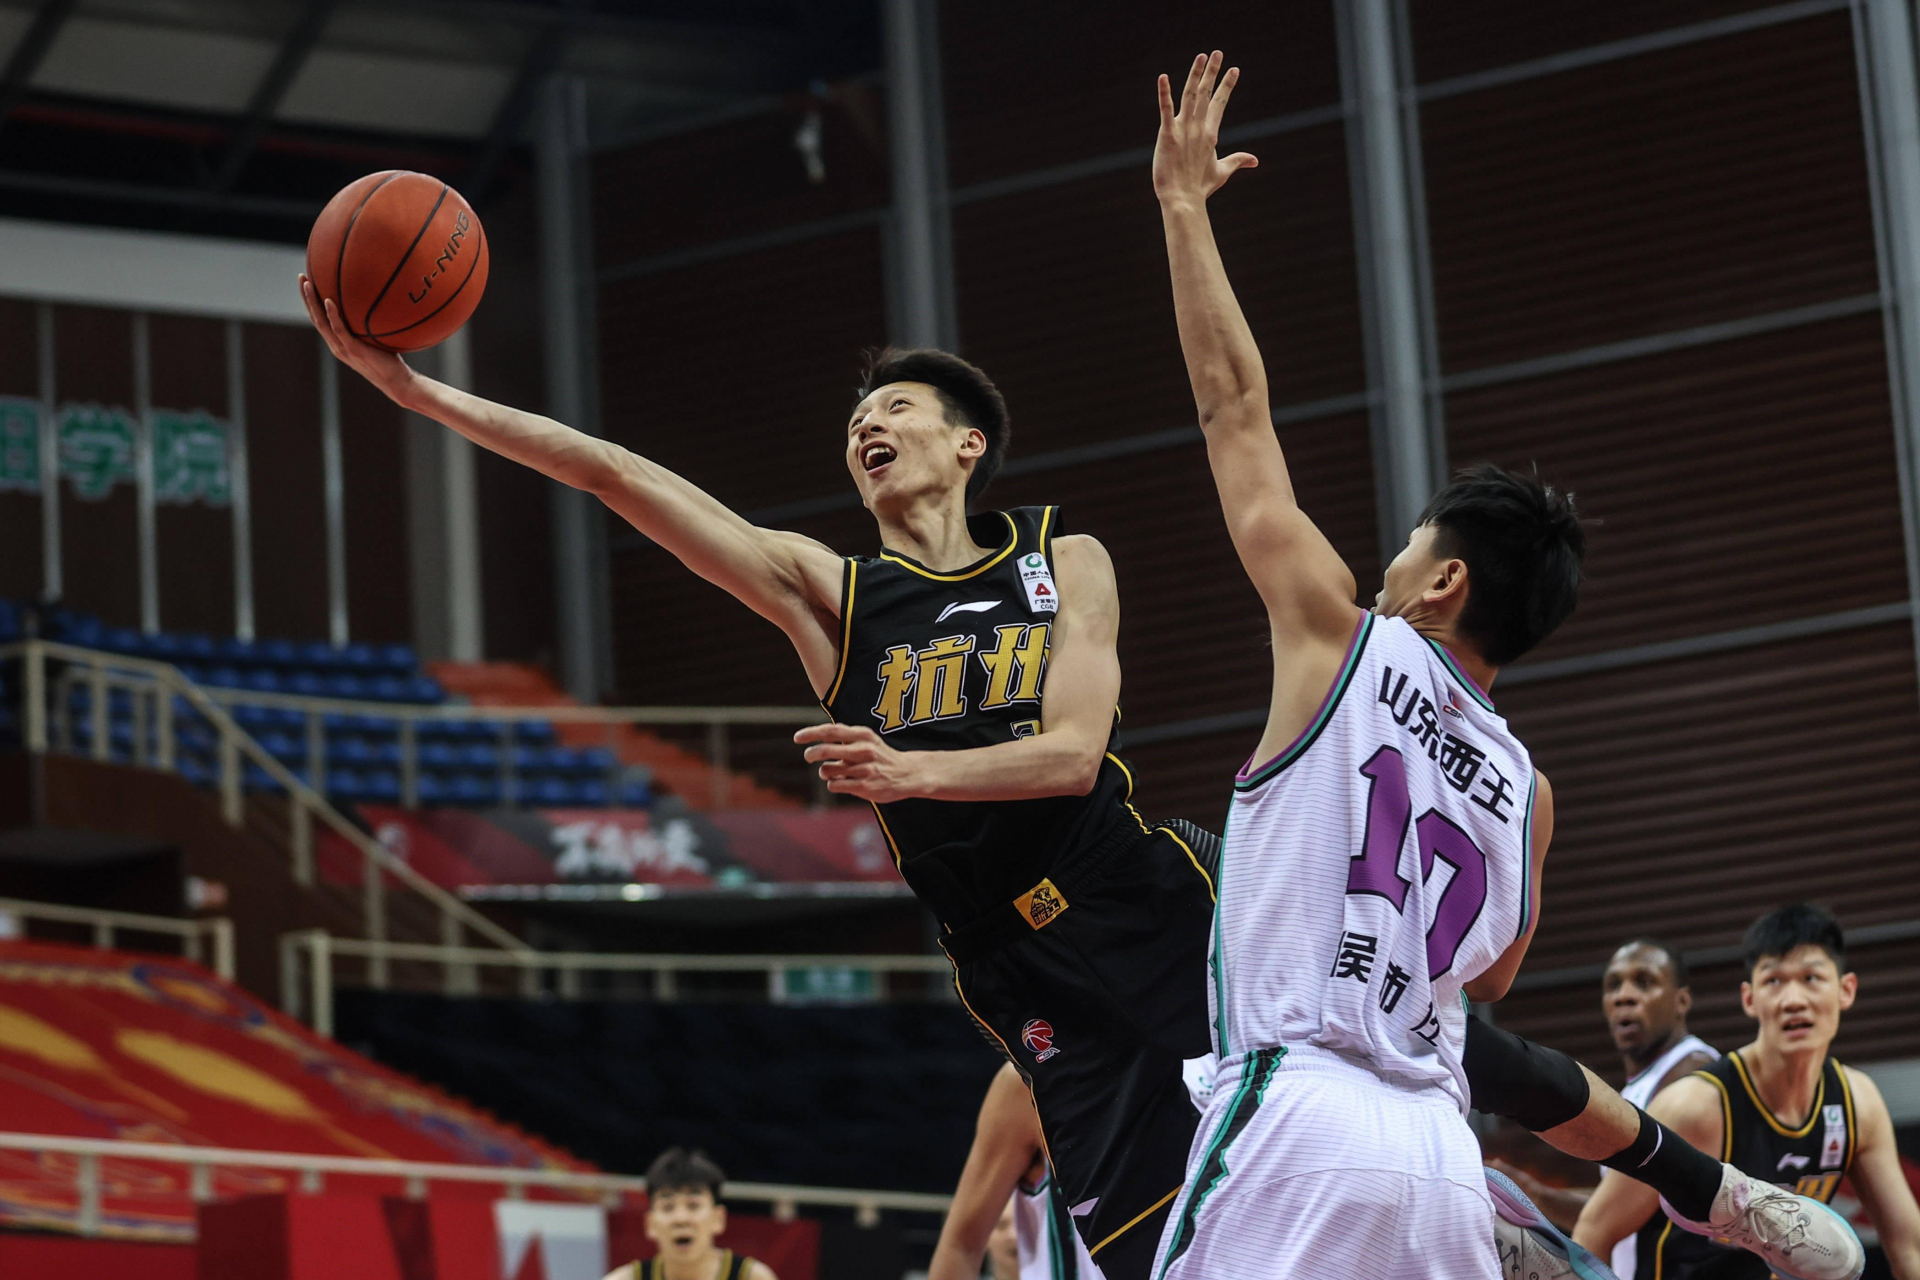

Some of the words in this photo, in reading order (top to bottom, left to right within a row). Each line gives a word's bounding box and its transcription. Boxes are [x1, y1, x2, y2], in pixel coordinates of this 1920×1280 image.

[408, 211, 470, 304] LI-NING
[870, 622, 1051, 734] 杭州
[1377, 665, 1515, 825] 山东西王
[1345, 743, 1488, 983] 10
